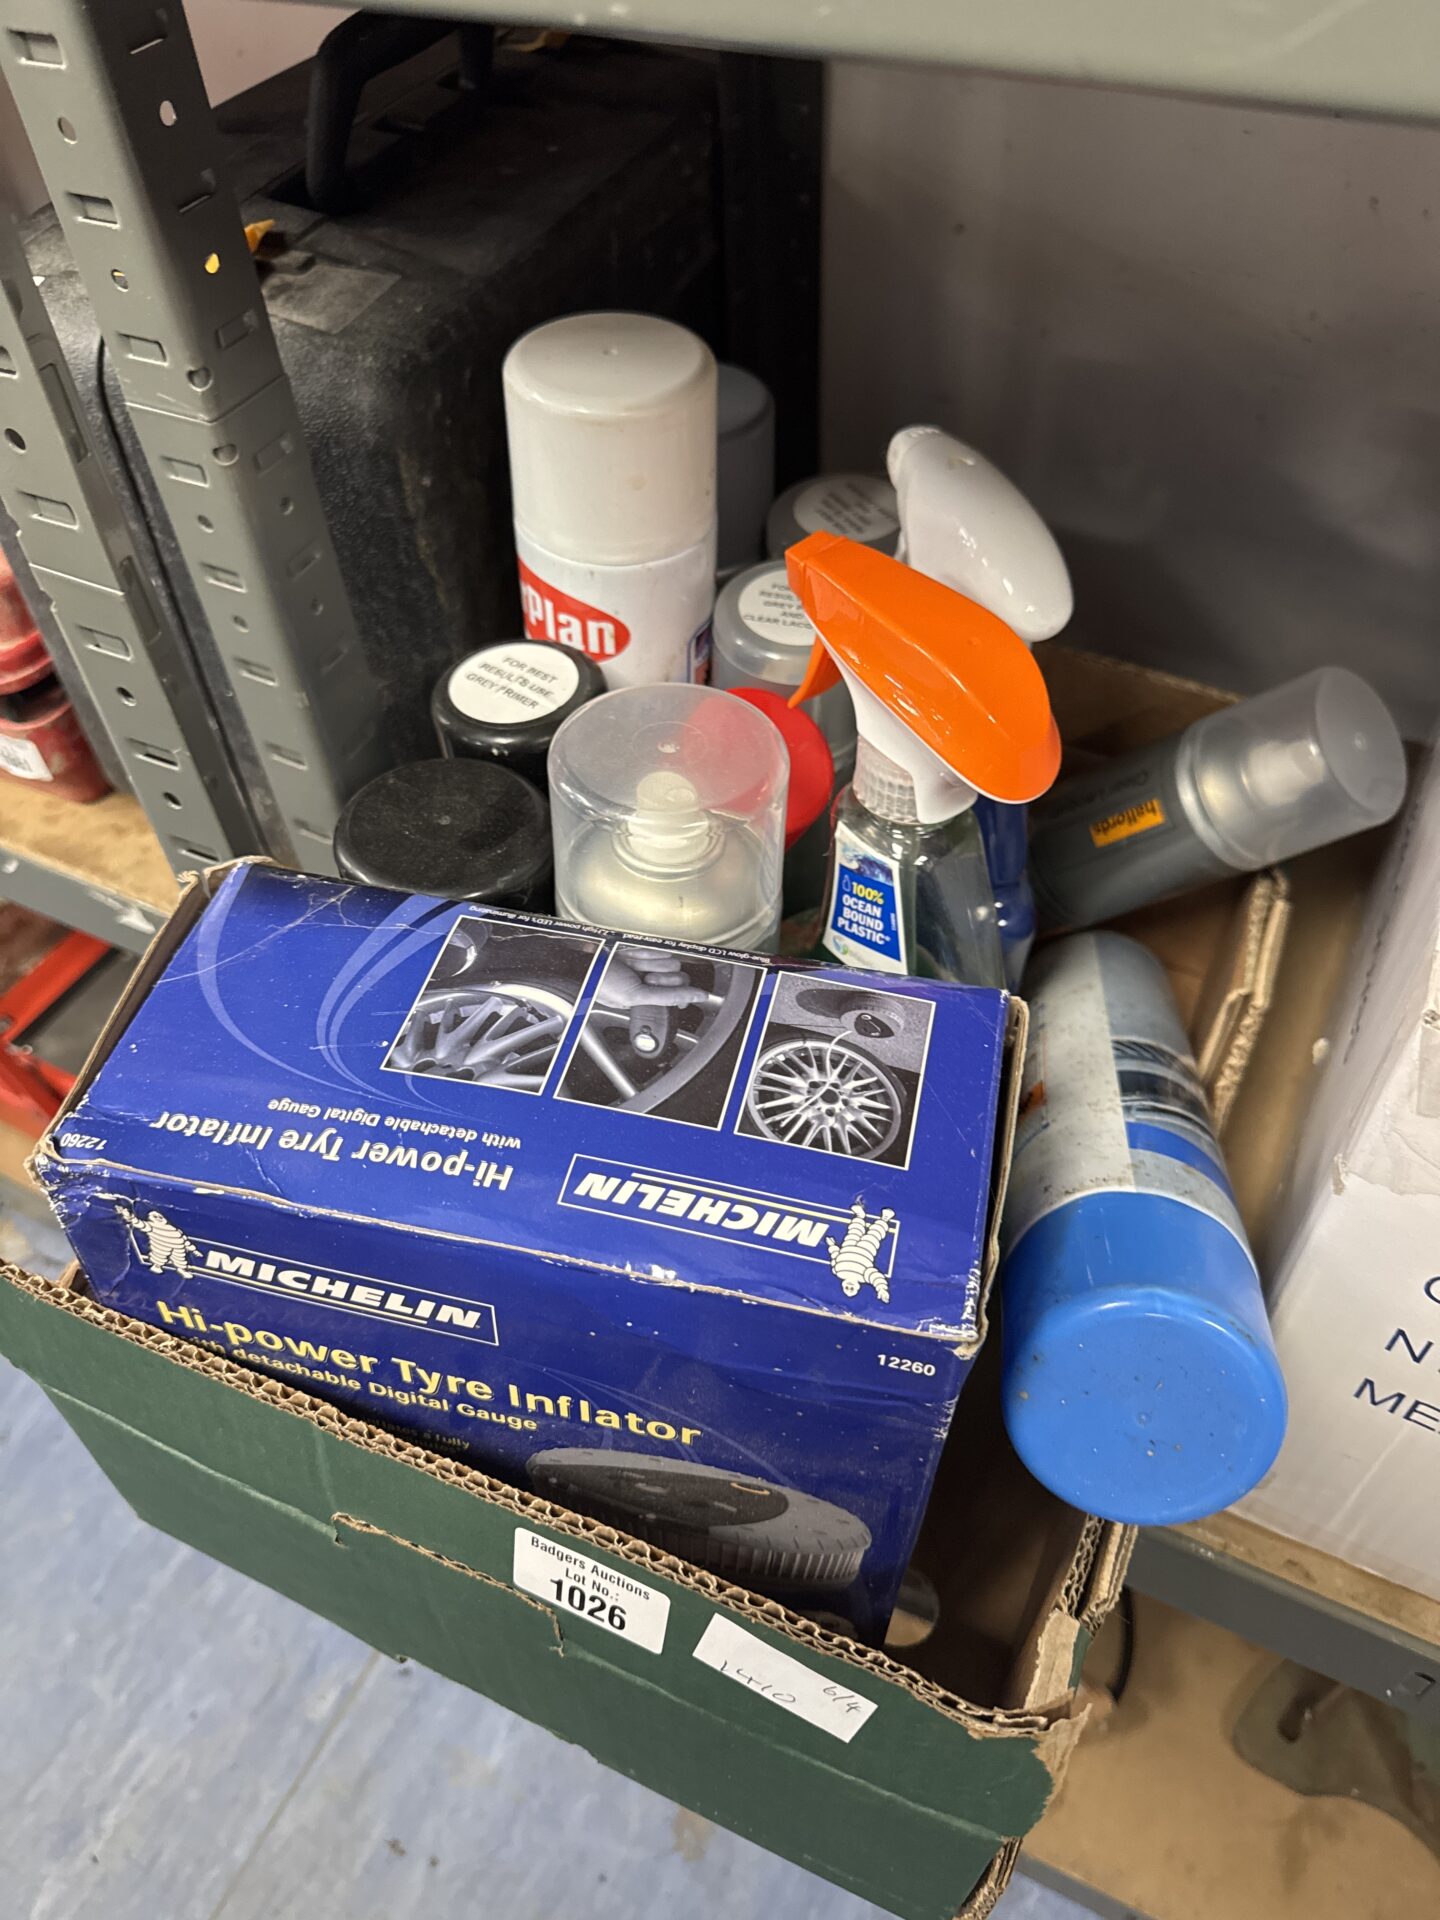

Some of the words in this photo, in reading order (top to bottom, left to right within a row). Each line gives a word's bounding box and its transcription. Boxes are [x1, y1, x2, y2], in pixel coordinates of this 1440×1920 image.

[478, 663, 530, 688] RESULTS
[529, 683, 555, 698] USE
[503, 656, 528, 671] FOR
[526, 667, 558, 684] BEST
[465, 672, 499, 691] GREY
[496, 684, 540, 710] PRIMER
[1091, 799, 1158, 834] halfords
[842, 893, 882, 918] OCEAN
[852, 881, 885, 905] 100%
[469, 904, 518, 920] illuminating
[518, 914, 530, 922] for
[532, 917, 553, 926] LED's
[843, 906, 884, 931] BOUND
[554, 920, 581, 930] power
[664, 939, 677, 947] for
[678, 941, 708, 953] display
[709, 946, 726, 956] LCD
[267, 1098, 322, 1118] Gauge
[324, 1107, 381, 1128] Digital
[60, 1132, 107, 1150] 12260
[149, 1111, 273, 1150] Inflator
[385, 1115, 479, 1143] detachable
[483, 1131, 521, 1150] with
[279, 1127, 344, 1162] Tyre
[351, 1139, 514, 1191] Hi-power
[574, 1173, 829, 1248] MICHELIN
[205, 1250, 481, 1329] MICHELIN
[157, 1300, 379, 1374] Hi-power
[391, 1357, 494, 1400] Tyre
[508, 1383, 701, 1445] Inflator
[877, 1353, 936, 1377] 12260
[232, 1348, 361, 1390] detachable
[368, 1381, 449, 1411] Digital
[457, 1403, 538, 1431] Gauge
[531, 1536, 586, 1569] Badgers
[591, 1565, 650, 1600] Auctions
[565, 1568, 586, 1586] Lot
[550, 1578, 627, 1631] 1026
